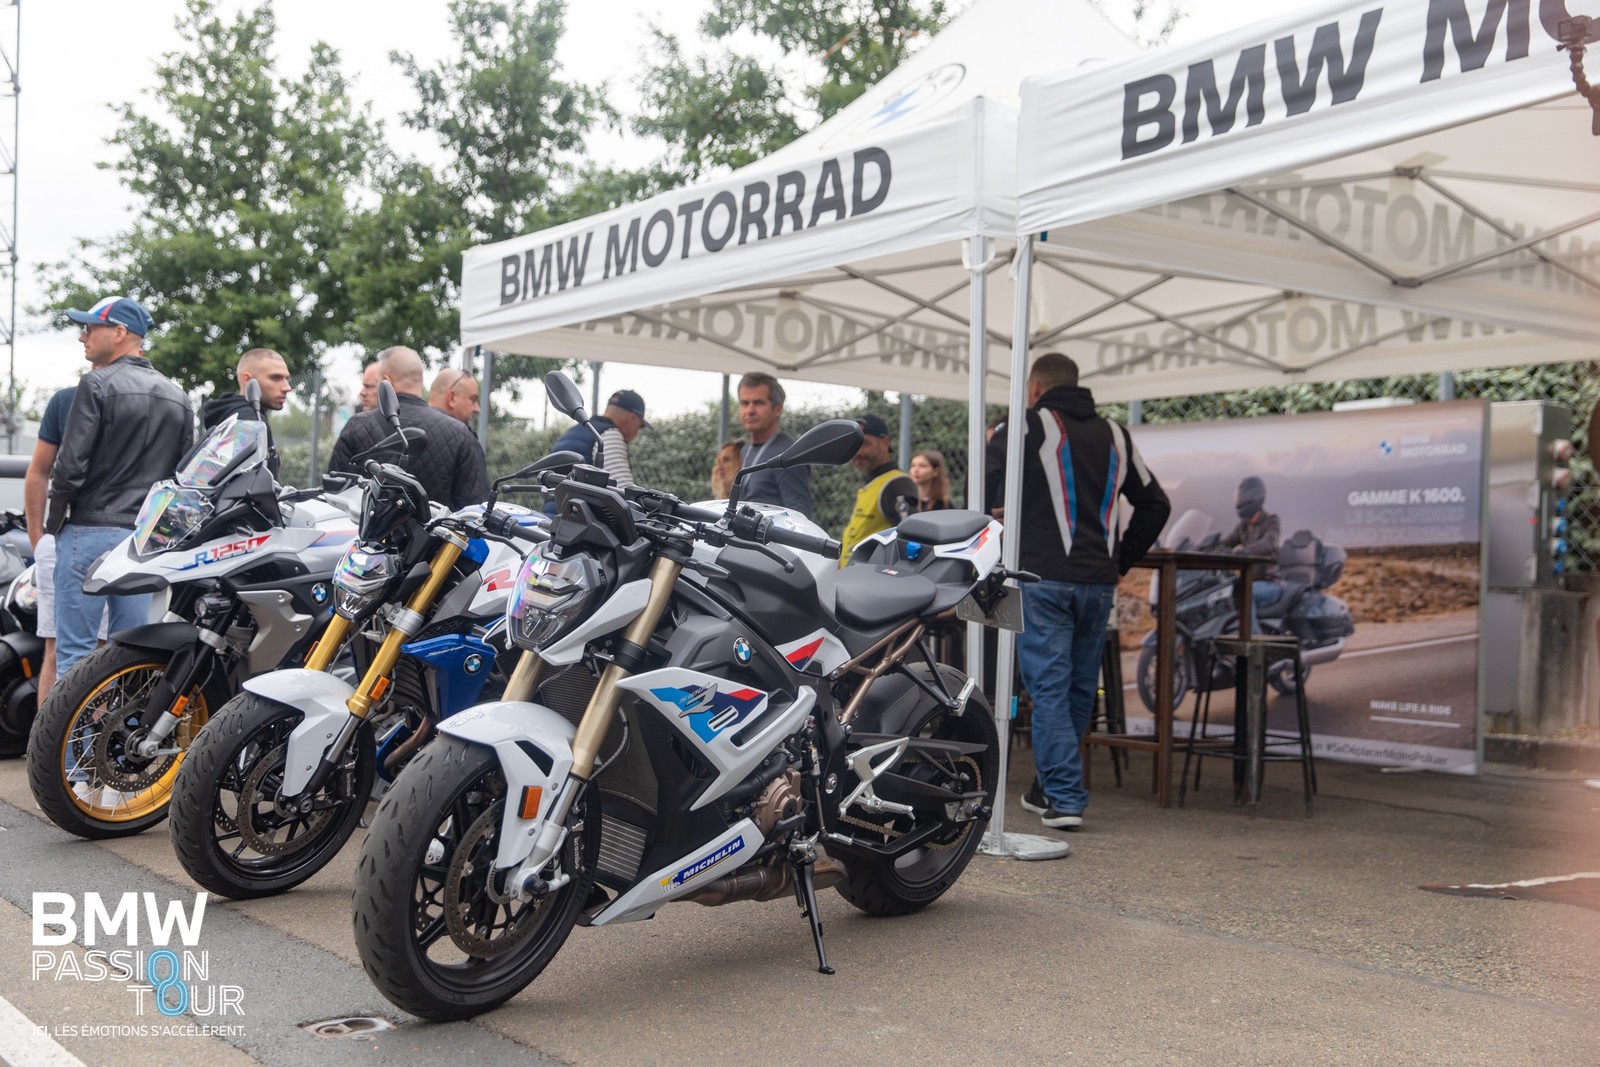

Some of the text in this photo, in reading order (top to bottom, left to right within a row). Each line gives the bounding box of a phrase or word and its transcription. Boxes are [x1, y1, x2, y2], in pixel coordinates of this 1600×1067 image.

[1121, 8, 1384, 160] BMW
[501, 146, 892, 305] BMW MOTORRAD
[1348, 488, 1407, 506] GAMME
[1409, 488, 1422, 504] K
[1370, 700, 1451, 716] MAKE LIFE A RIDE
[573, 836, 581, 869] brembo
[683, 840, 741, 879] MICHELIN
